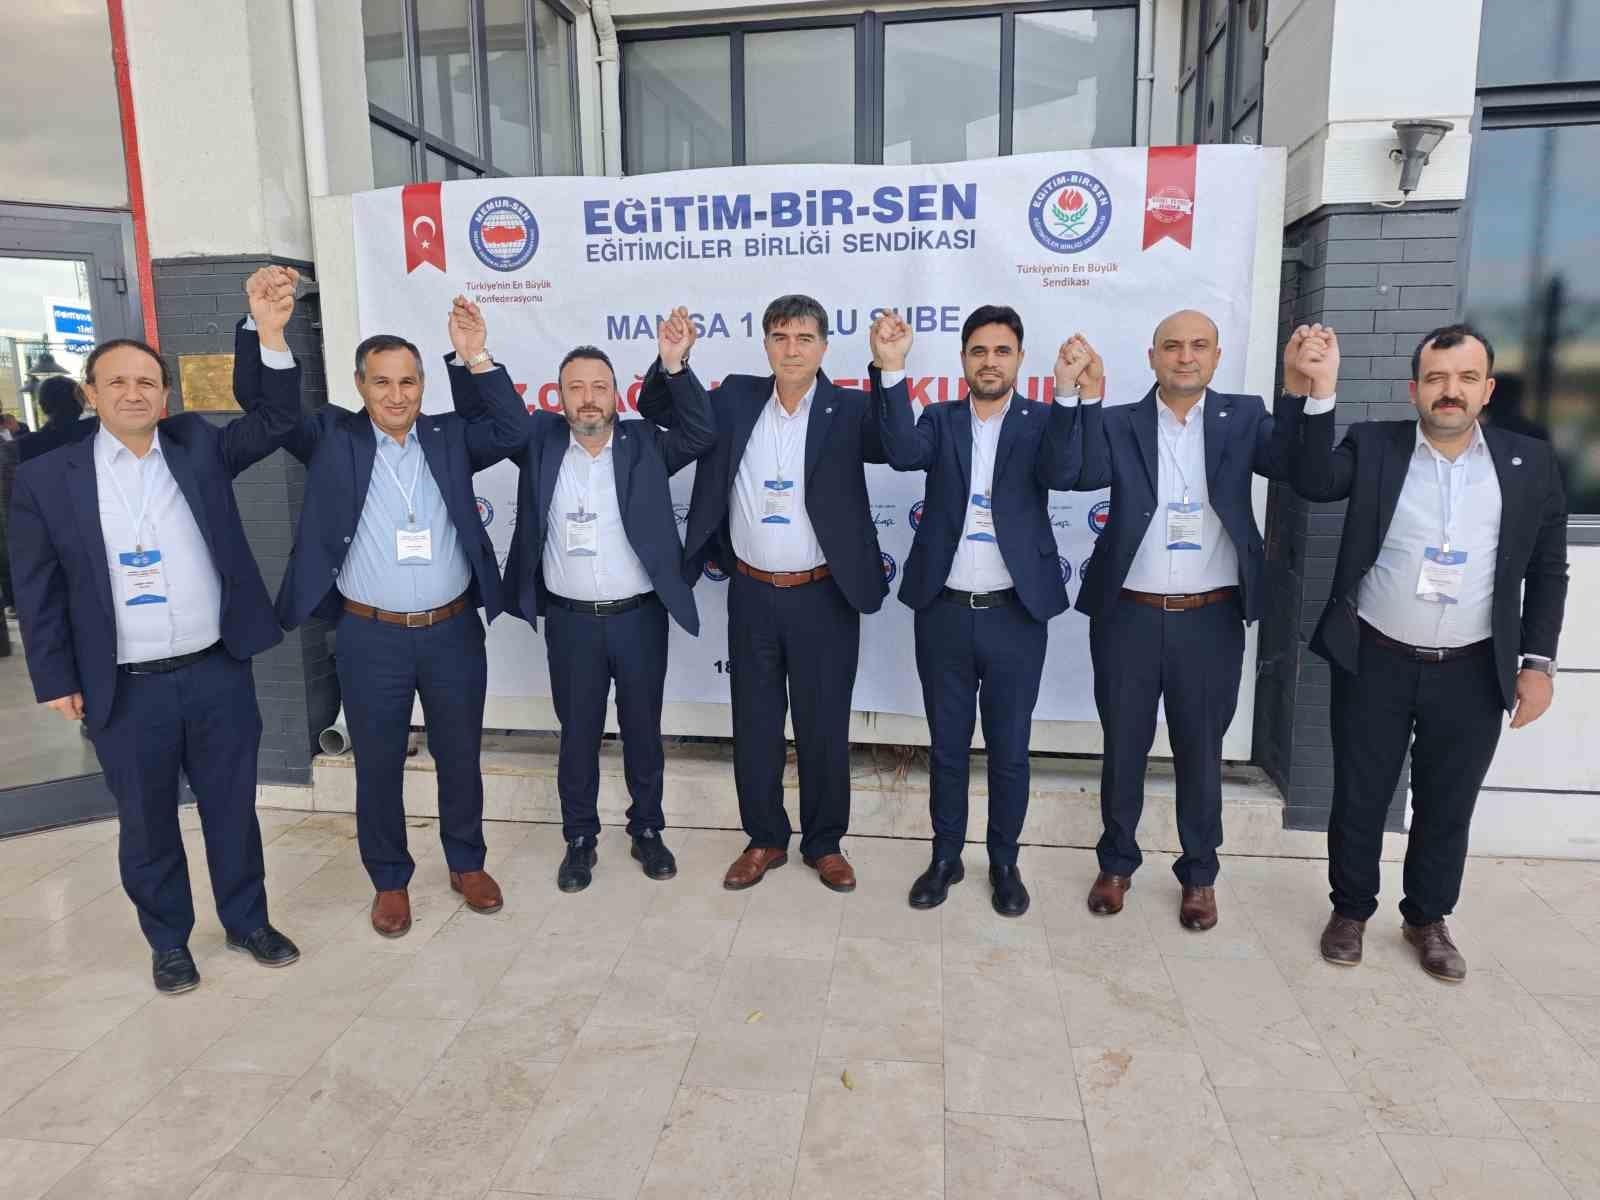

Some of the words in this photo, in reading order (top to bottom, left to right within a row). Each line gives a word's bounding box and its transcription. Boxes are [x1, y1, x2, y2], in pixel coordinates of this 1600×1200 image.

[586, 236, 732, 262] EĞİTİMCİLER
[745, 231, 830, 257] BİRLİĞİ
[843, 226, 976, 253] SENDİKASI
[1072, 263, 1084, 273] En
[1088, 262, 1119, 273] Büyük
[512, 281, 523, 289] En
